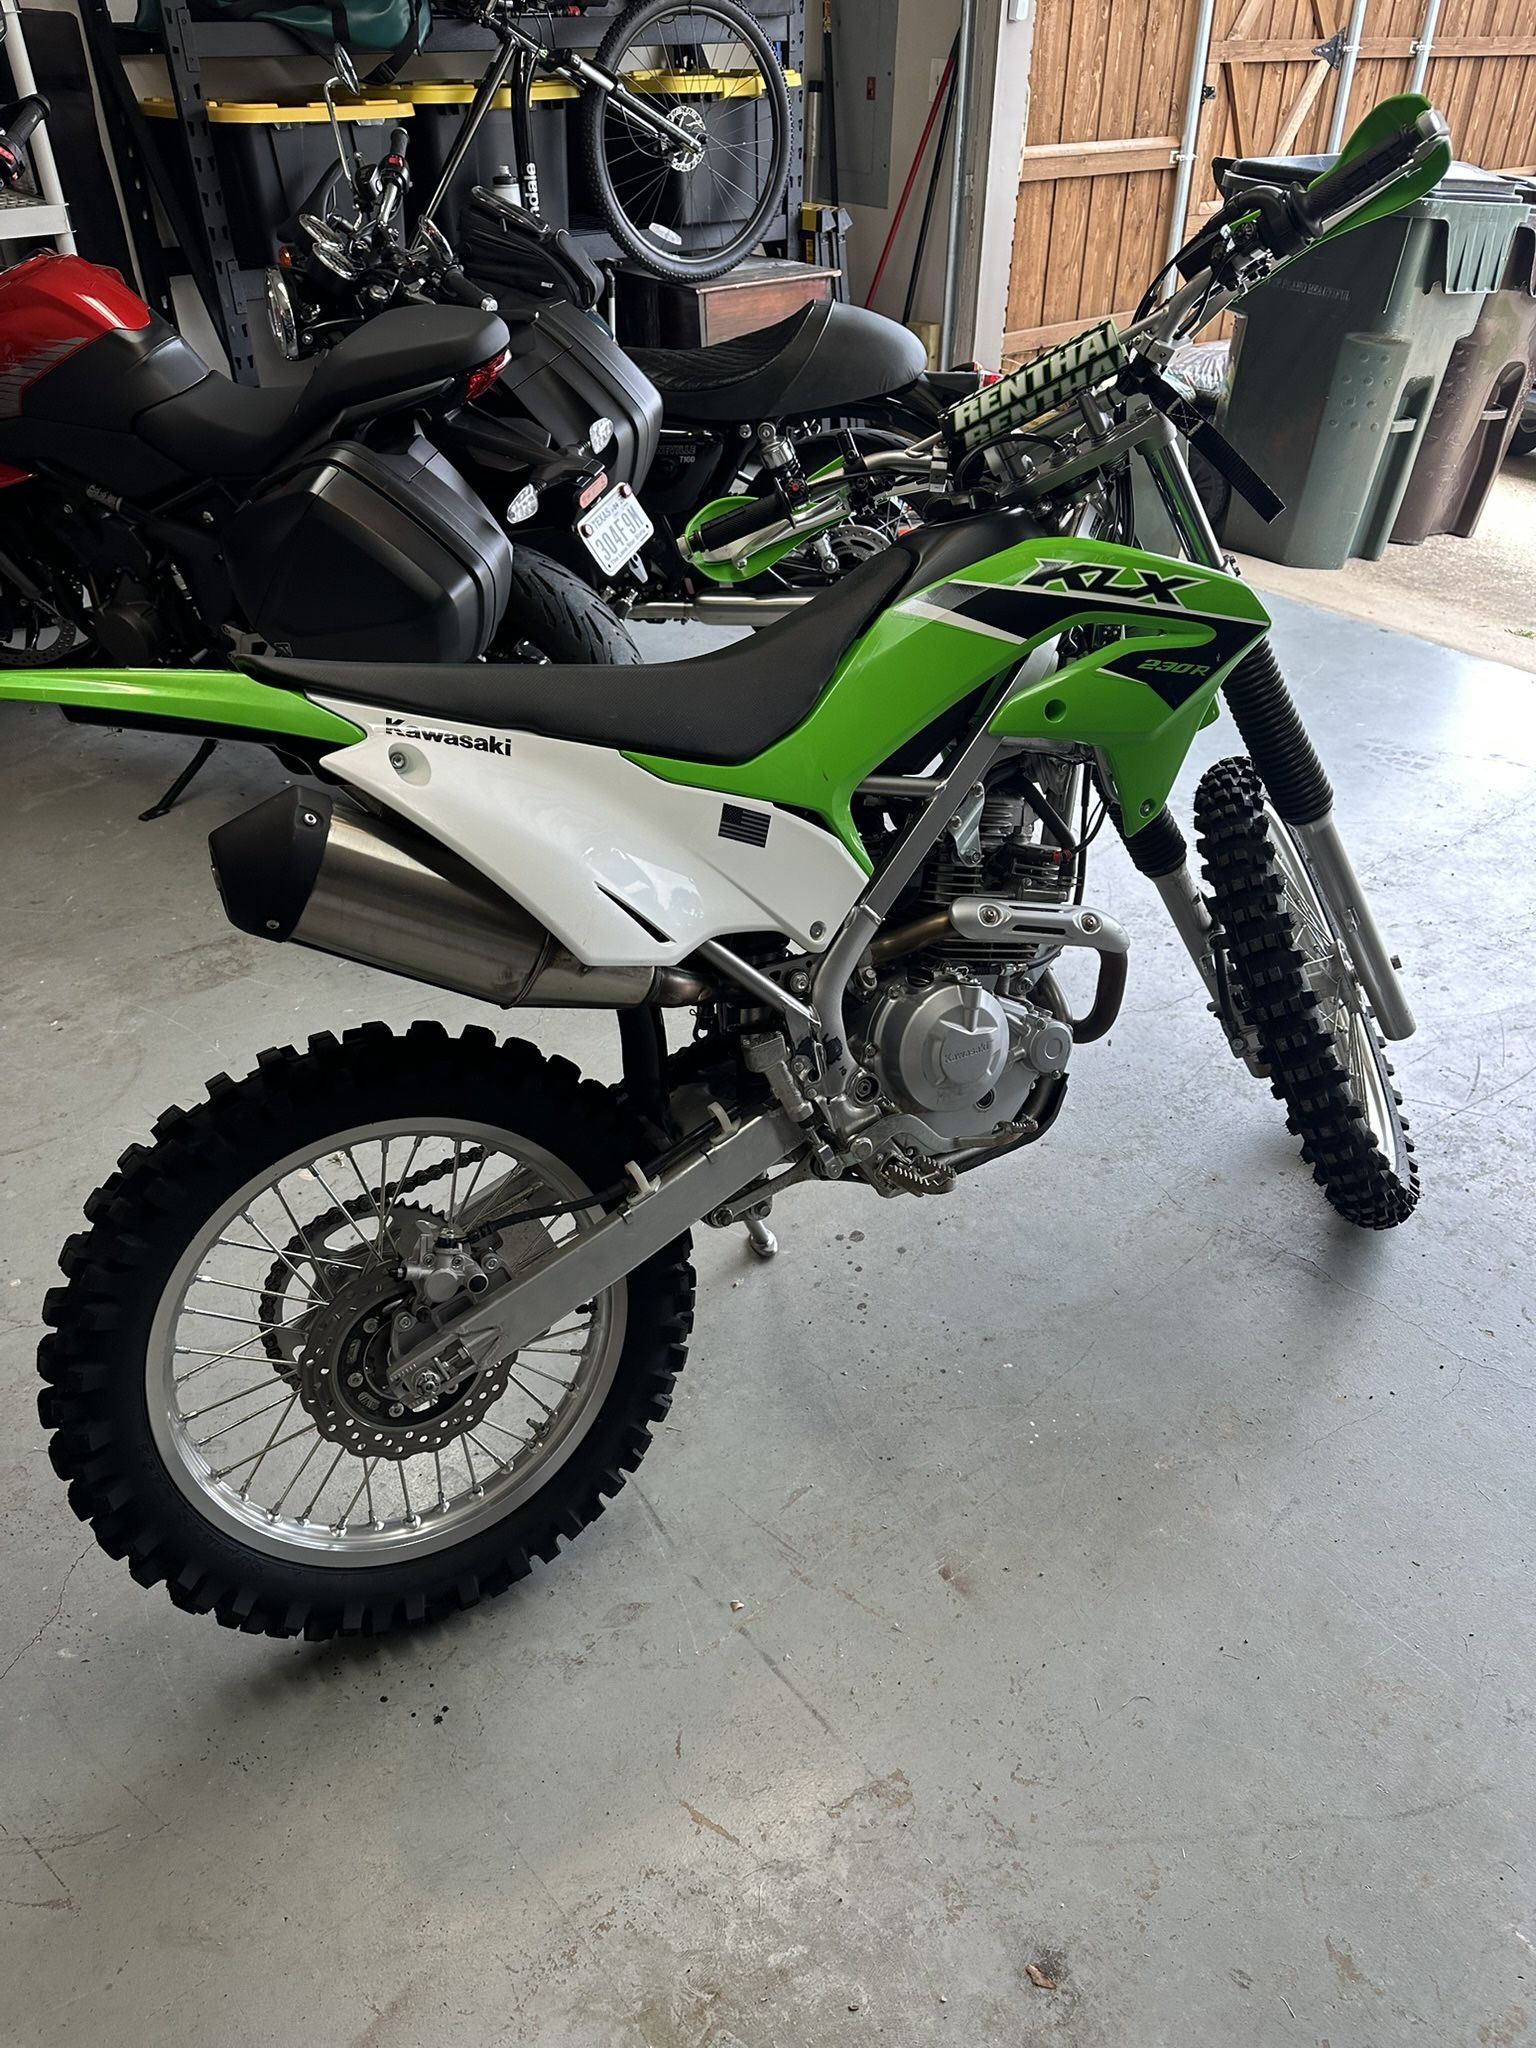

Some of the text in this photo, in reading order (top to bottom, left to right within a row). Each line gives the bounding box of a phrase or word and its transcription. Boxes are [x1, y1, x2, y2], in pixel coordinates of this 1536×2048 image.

[591, 507, 612, 529] TEXAS
[1014, 557, 1211, 610] KLX
[1136, 658, 1211, 677] 230R
[385, 716, 512, 757] Kawasaki
